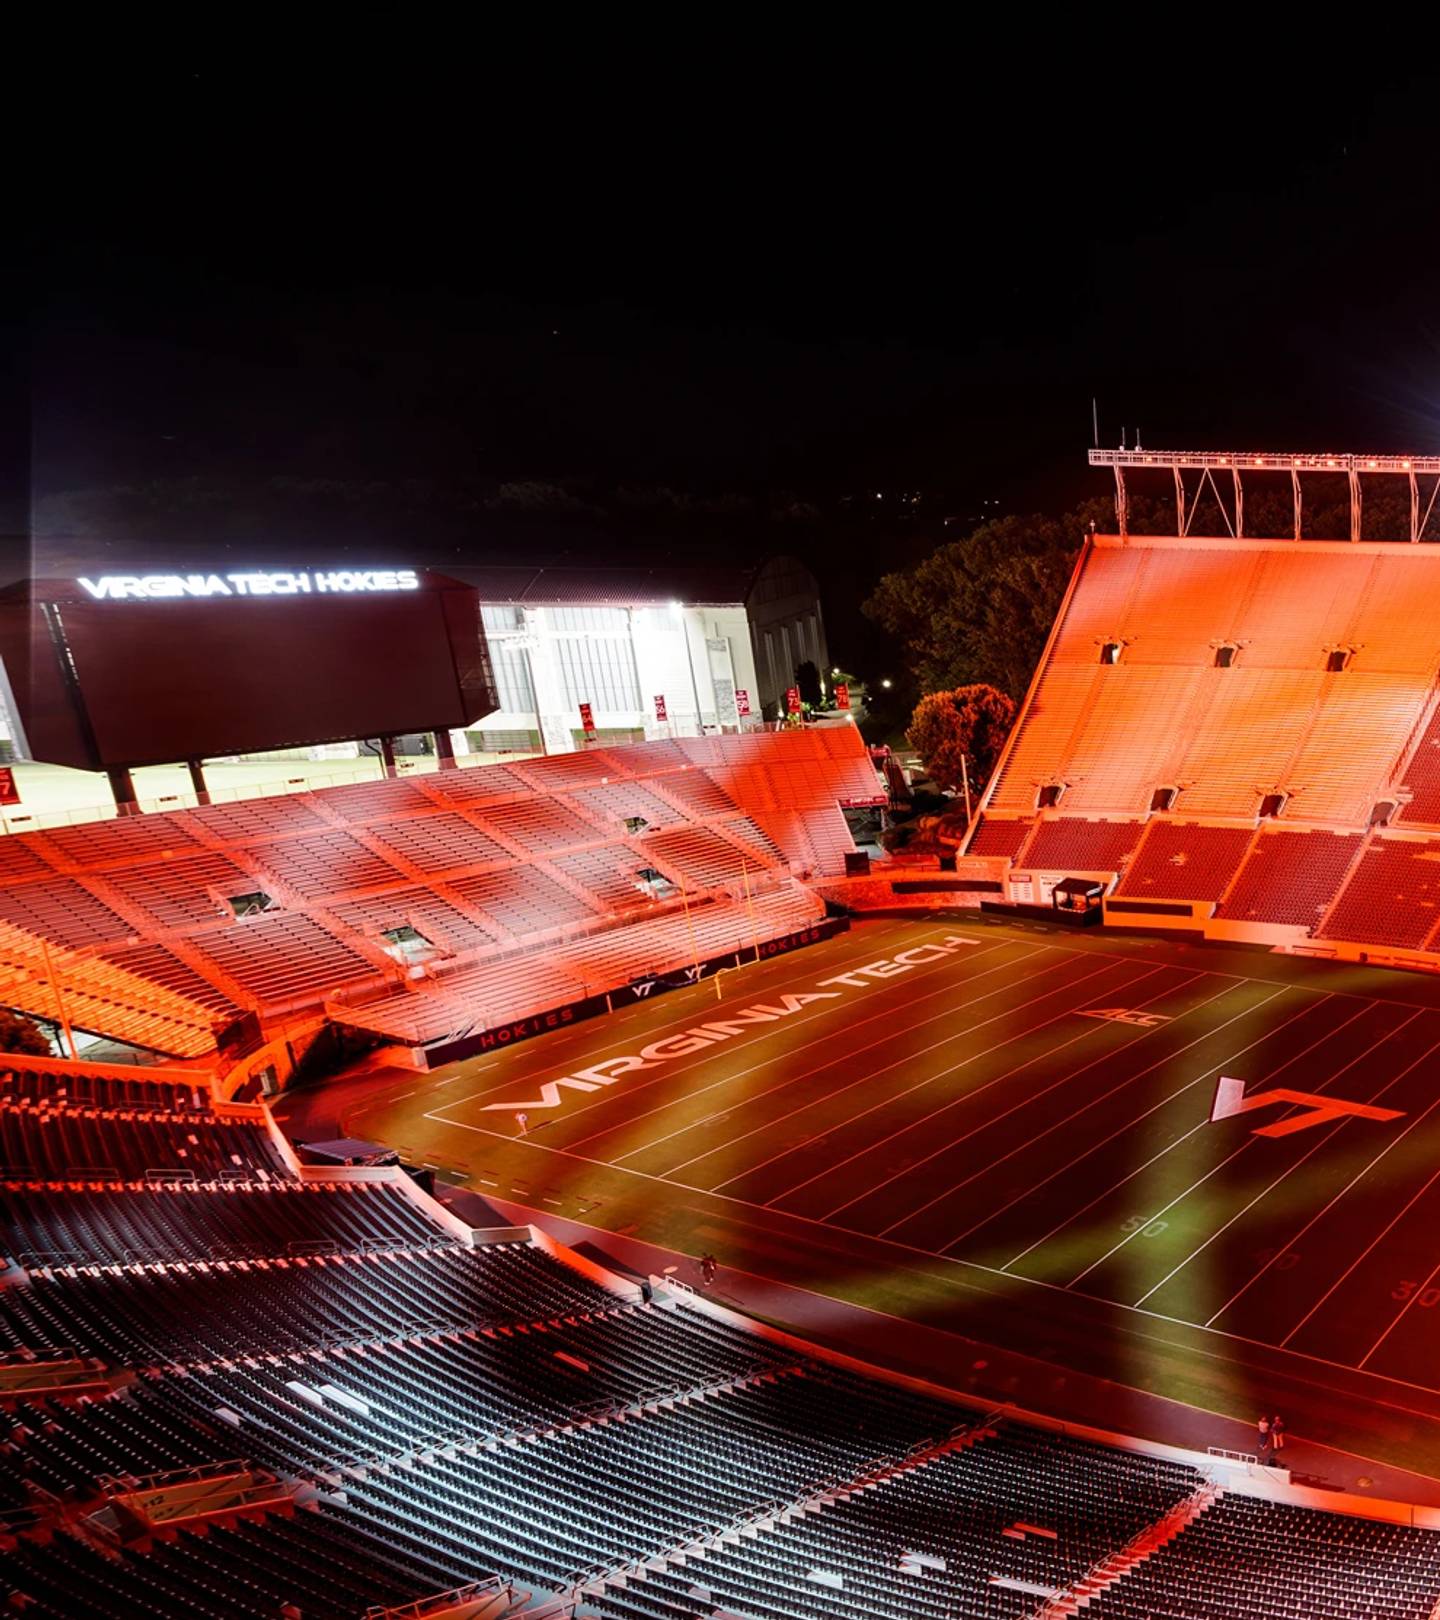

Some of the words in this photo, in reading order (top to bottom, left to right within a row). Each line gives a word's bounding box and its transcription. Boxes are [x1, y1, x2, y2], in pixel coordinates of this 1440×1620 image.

[76, 574, 233, 599] VIRGINIA
[226, 572, 312, 595] TECH
[314, 570, 420, 593] HOKIES
[684, 964, 708, 981] VT
[632, 981, 656, 997] VT
[479, 1008, 574, 1048] HOKIES
[480, 991, 843, 1112] VIRGINIA
[815, 935, 981, 989] TECH
[1209, 1075, 1408, 1139] VT
[1119, 1214, 1170, 1238] 50
